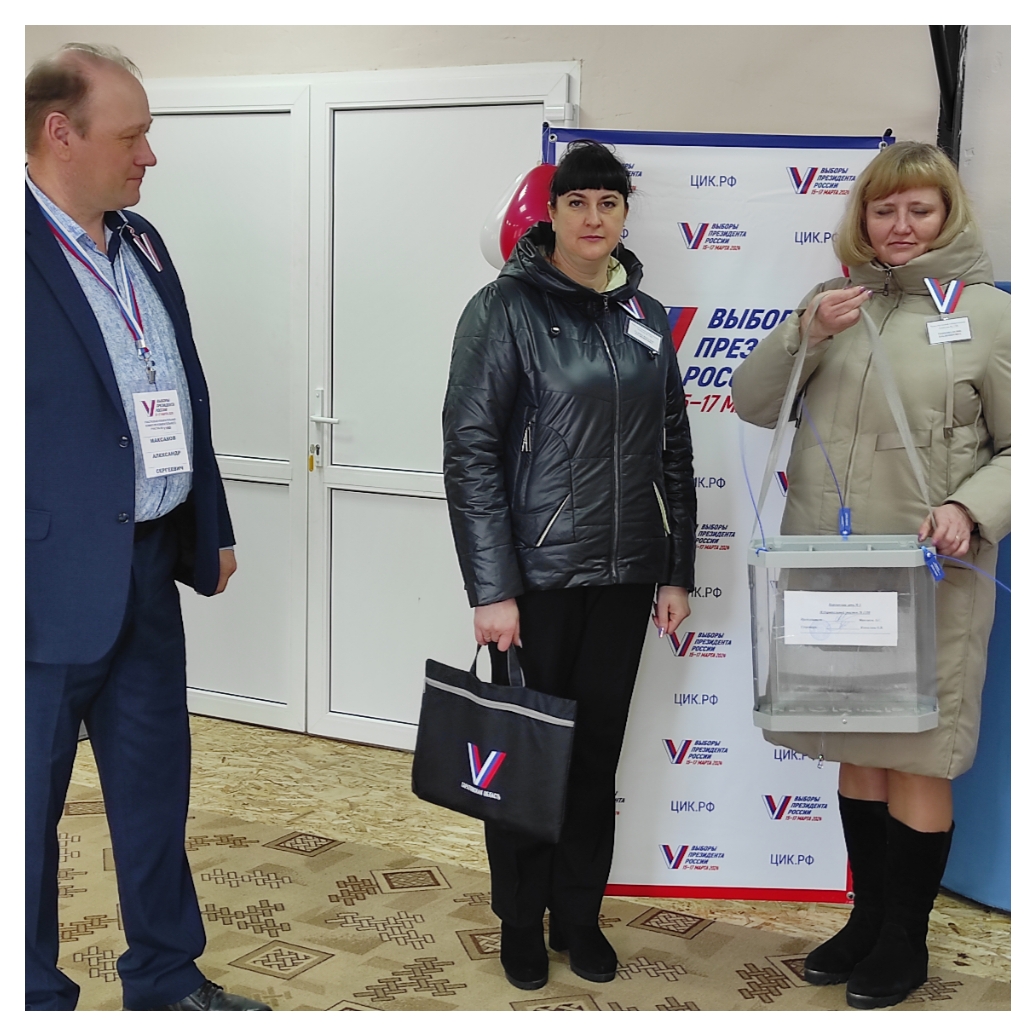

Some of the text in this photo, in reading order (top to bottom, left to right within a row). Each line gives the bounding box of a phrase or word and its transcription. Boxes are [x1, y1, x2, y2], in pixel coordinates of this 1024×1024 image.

[690, 174, 737, 189] ЦИК.РФ
[152, 450, 181, 458] АЛЕКСАНДР
[674, 693, 718, 706] ЦИК.РФ
[671, 801, 715, 813] ЦИК.РФ
[770, 854, 814, 866] ЦИК.РФ
